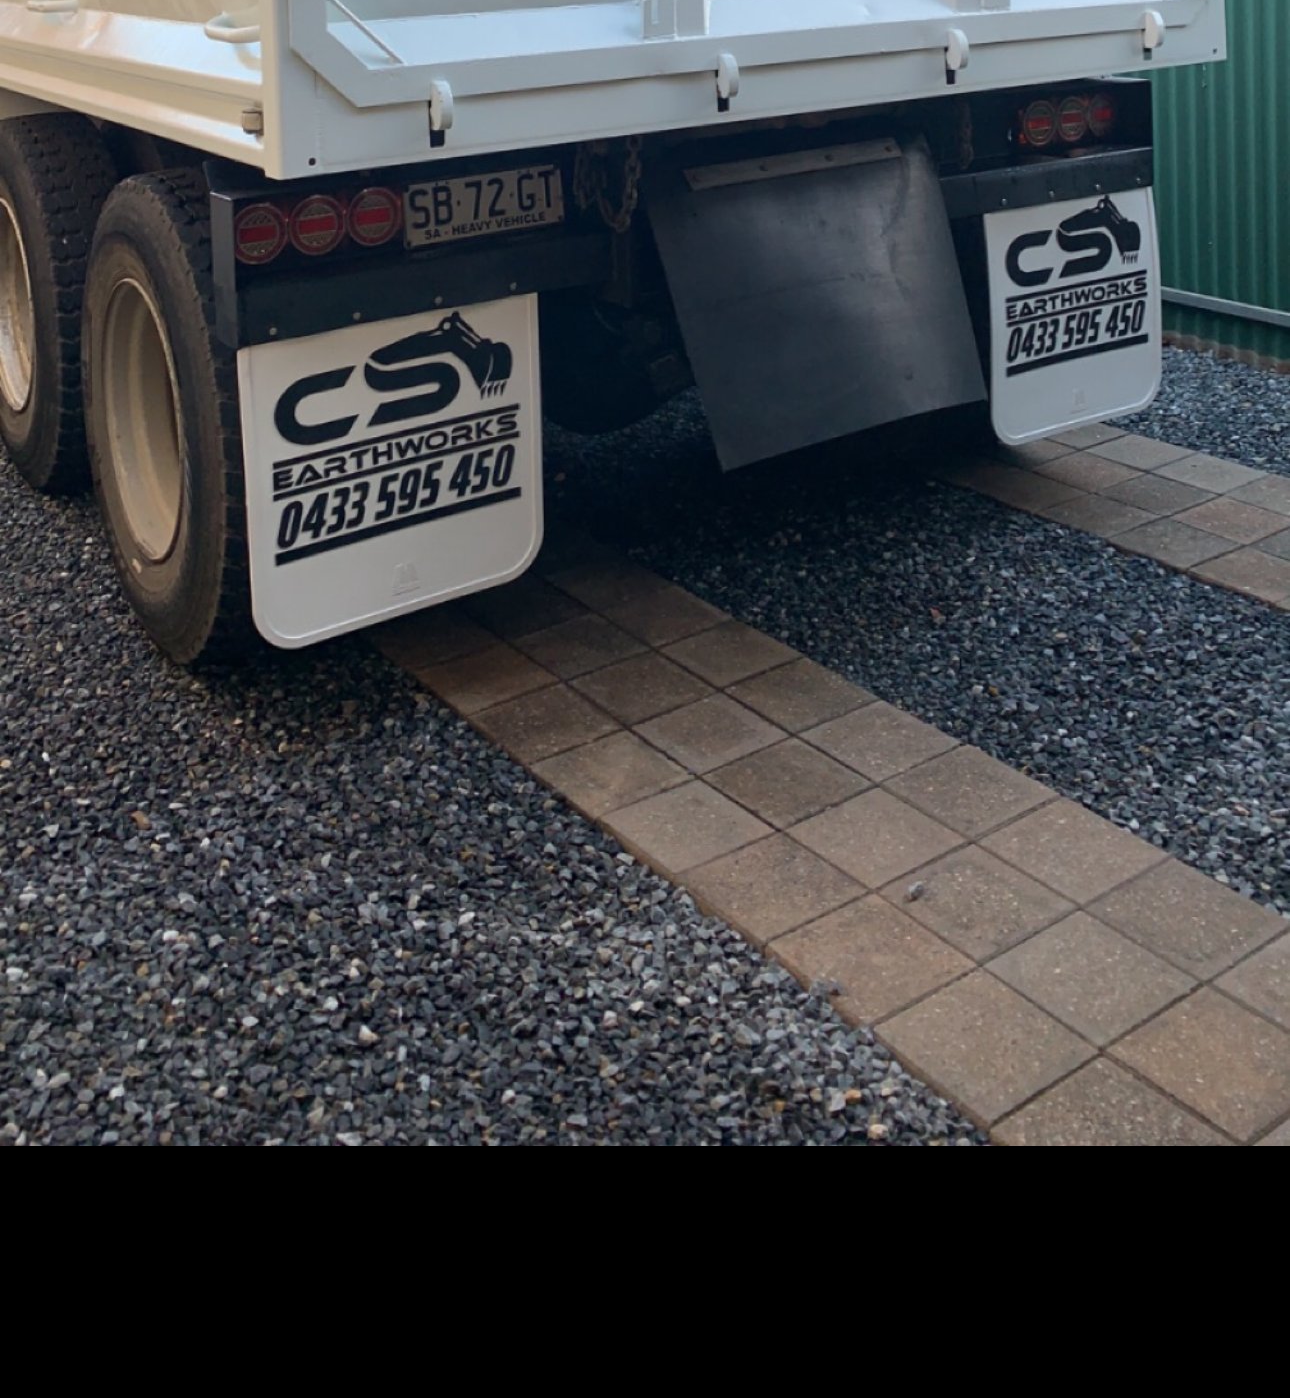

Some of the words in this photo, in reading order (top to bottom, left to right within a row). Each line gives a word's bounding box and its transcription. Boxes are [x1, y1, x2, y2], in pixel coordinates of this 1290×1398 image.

[408, 185, 454, 230] SB
[464, 177, 507, 221] 72
[516, 171, 555, 212] GT
[451, 220, 493, 236] HEAVY
[496, 211, 546, 229] VEHICLE
[1005, 206, 1114, 287] CS
[1005, 274, 1148, 321] EARTHWORKS
[1006, 317, 1059, 364] 0433
[1061, 309, 1101, 351] 595
[1104, 300, 1147, 339] 450
[273, 322, 461, 446] CS
[272, 413, 519, 492] EARTHWORKS
[276, 481, 371, 549] 0433
[374, 460, 444, 522] 595
[448, 444, 516, 498] 450
